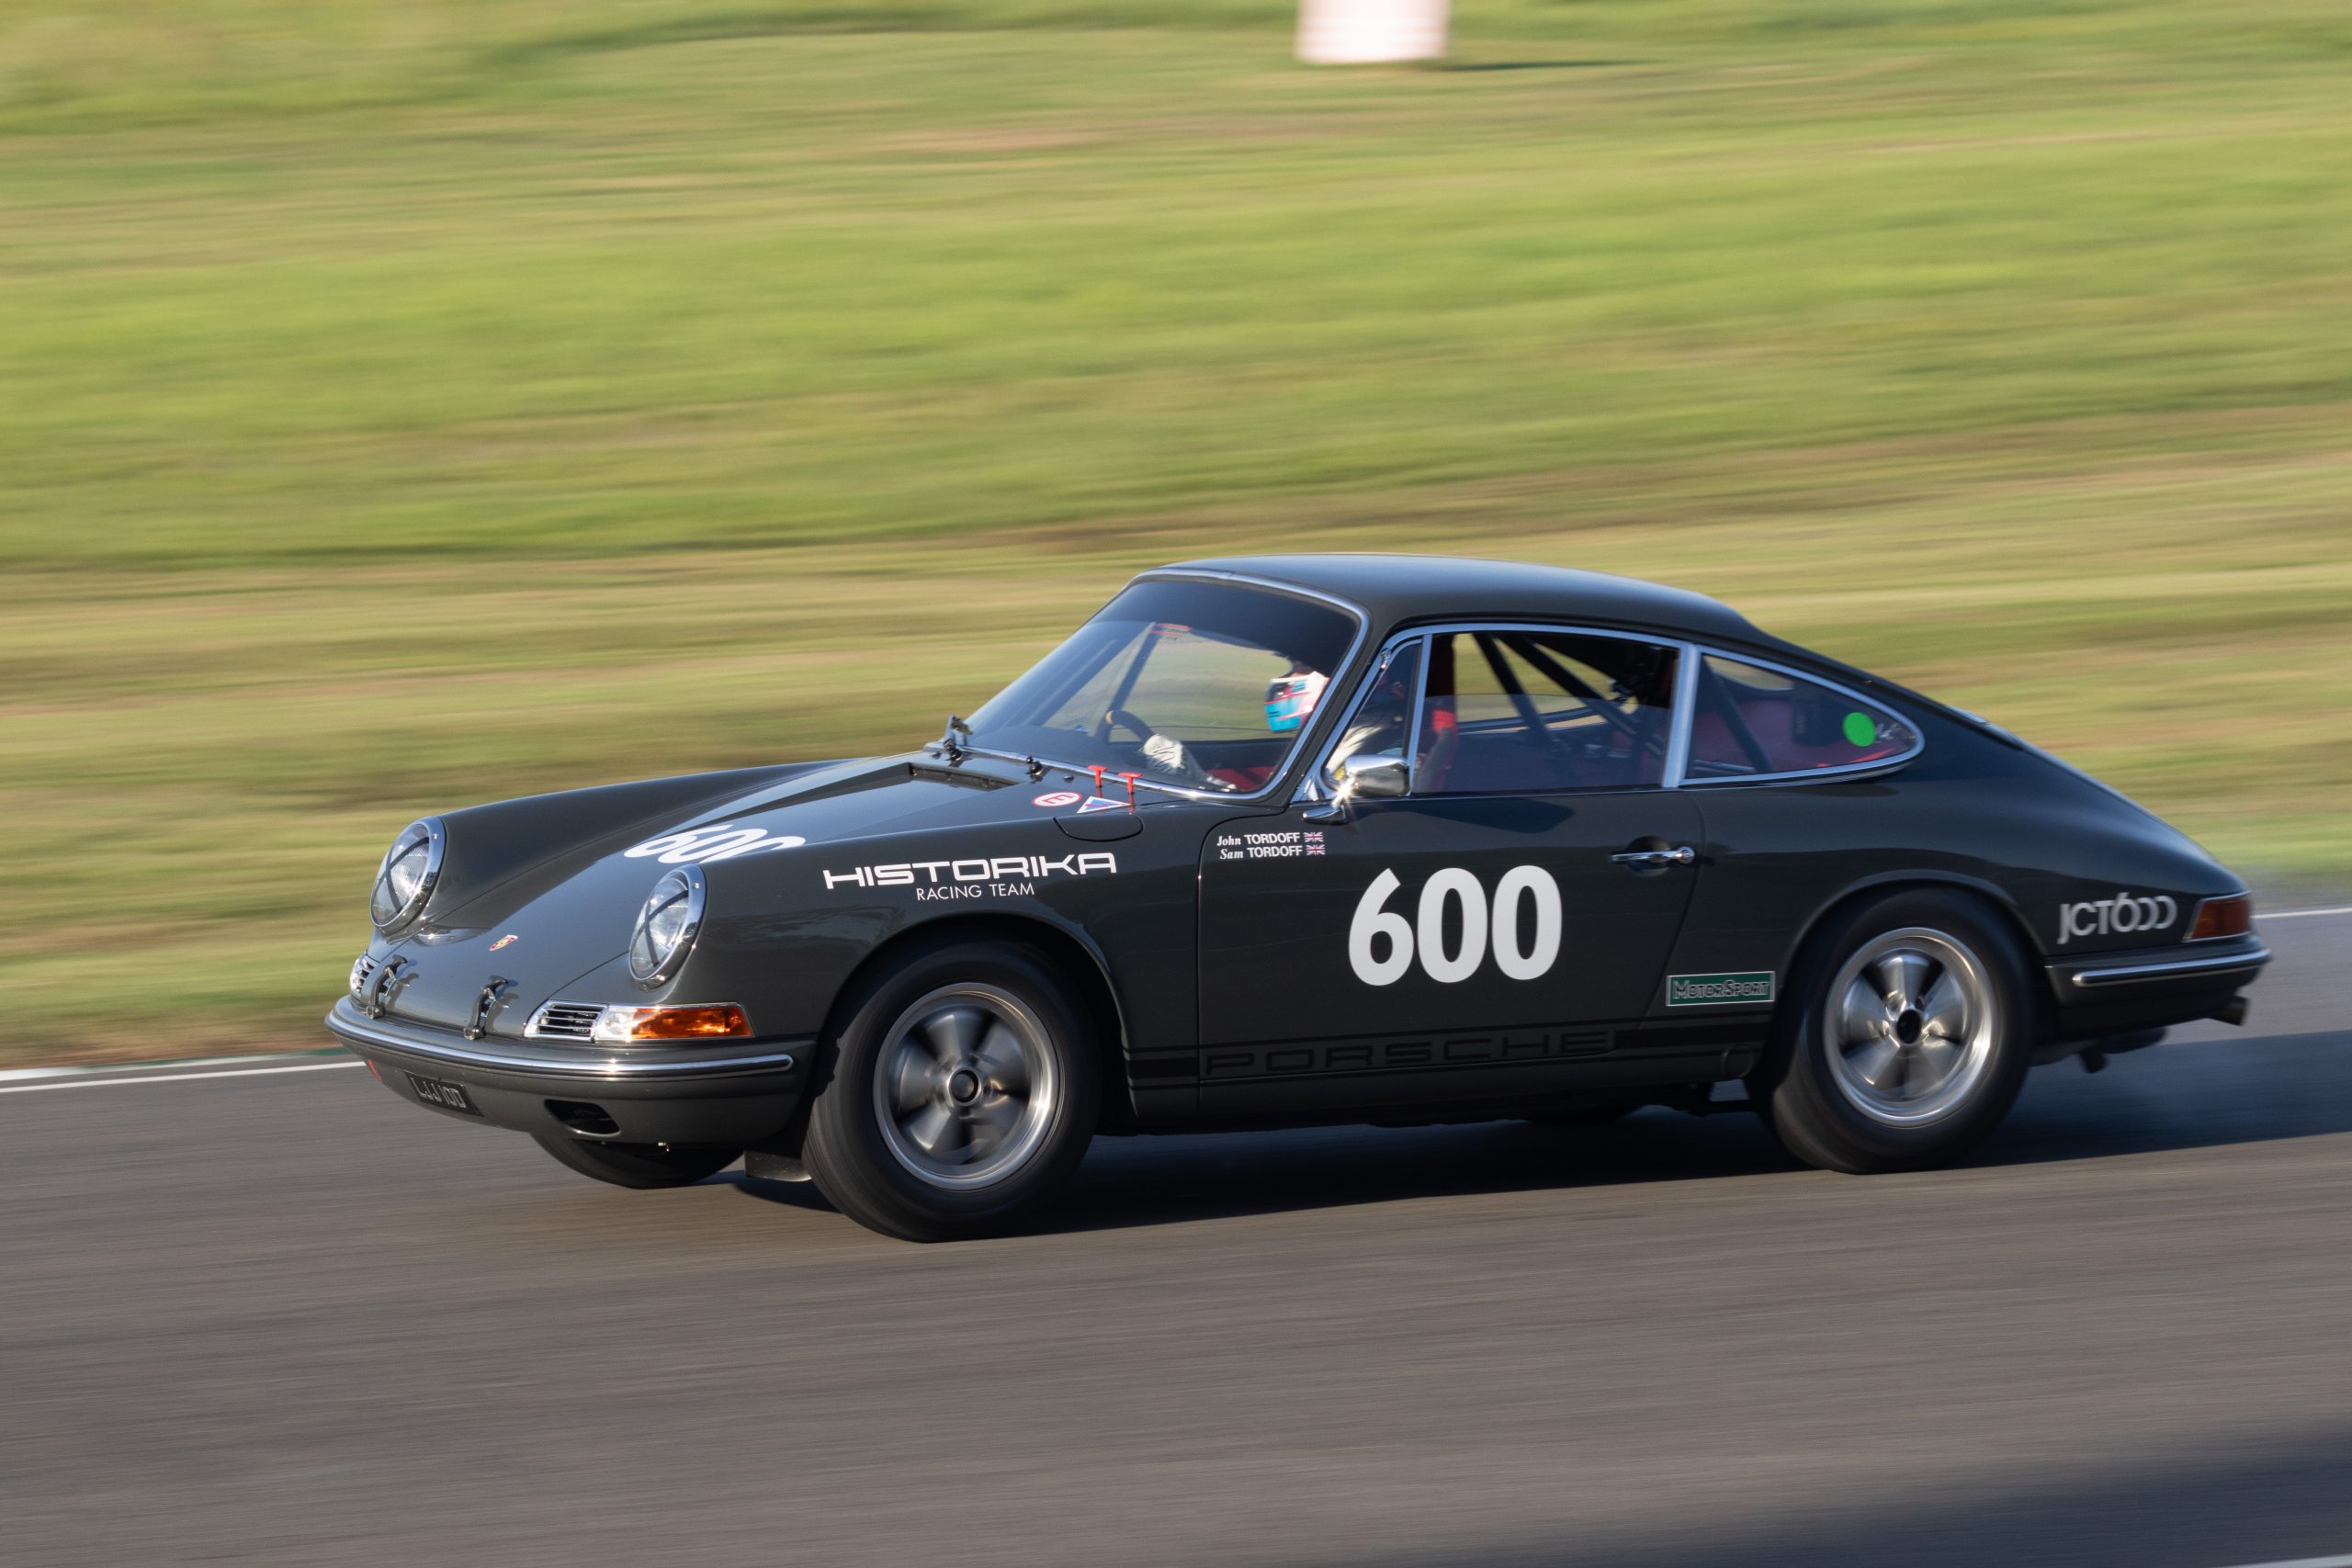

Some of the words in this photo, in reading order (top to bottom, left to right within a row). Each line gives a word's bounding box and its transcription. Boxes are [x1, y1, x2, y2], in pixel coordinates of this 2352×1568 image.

[1216, 835, 1241, 846] John
[1244, 832, 1300, 845] TORDOFF
[1219, 848, 1244, 860] Sam
[1247, 845, 1303, 858] TORDOFF
[822, 852, 1117, 890] HISTORIKA
[916, 884, 982, 901] RACING
[989, 882, 1035, 897] TEAM
[1348, 864, 1562, 987] 600
[2056, 892, 2178, 944] JCT600
[1205, 1030, 1610, 1077] PORSCHE
